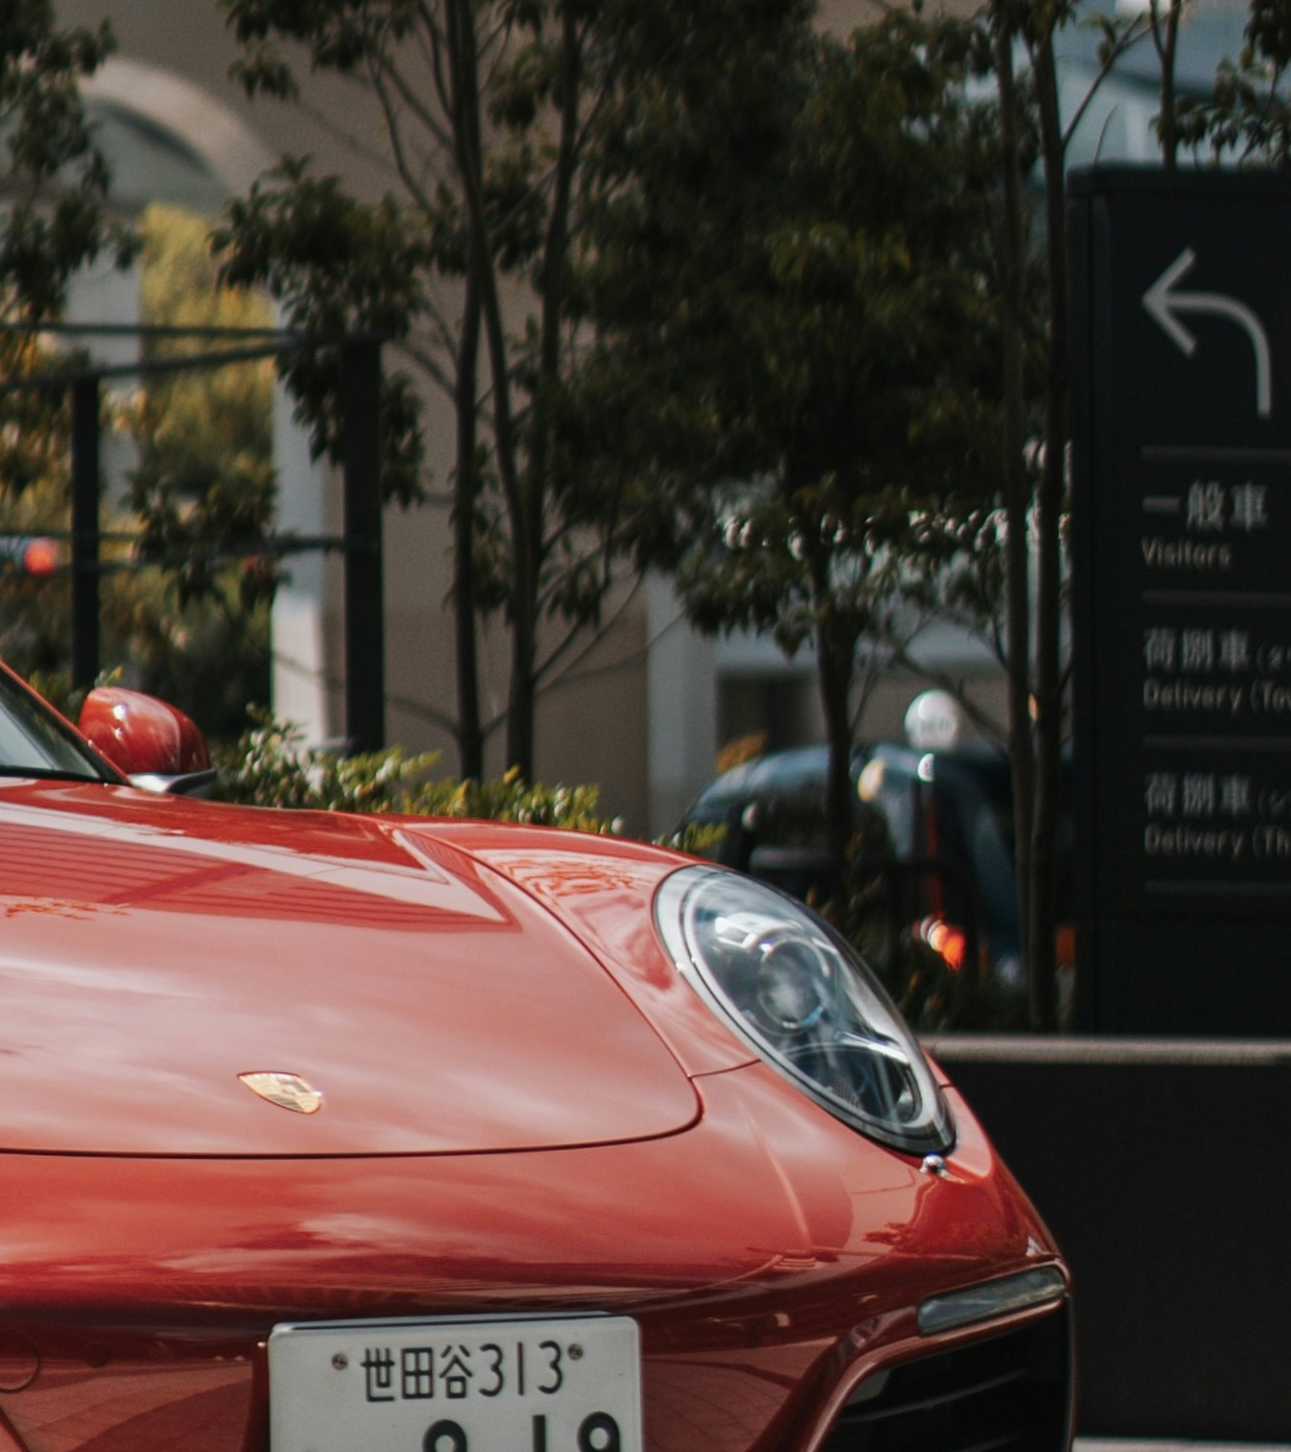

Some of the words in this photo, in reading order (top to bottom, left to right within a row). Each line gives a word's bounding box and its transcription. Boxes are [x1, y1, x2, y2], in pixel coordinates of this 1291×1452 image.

[1141, 479, 1269, 532] 一般車
[1140, 535, 1233, 570] Visitors
[1142, 677, 1245, 718] Delivery
[1143, 823, 1246, 864] Delivery
